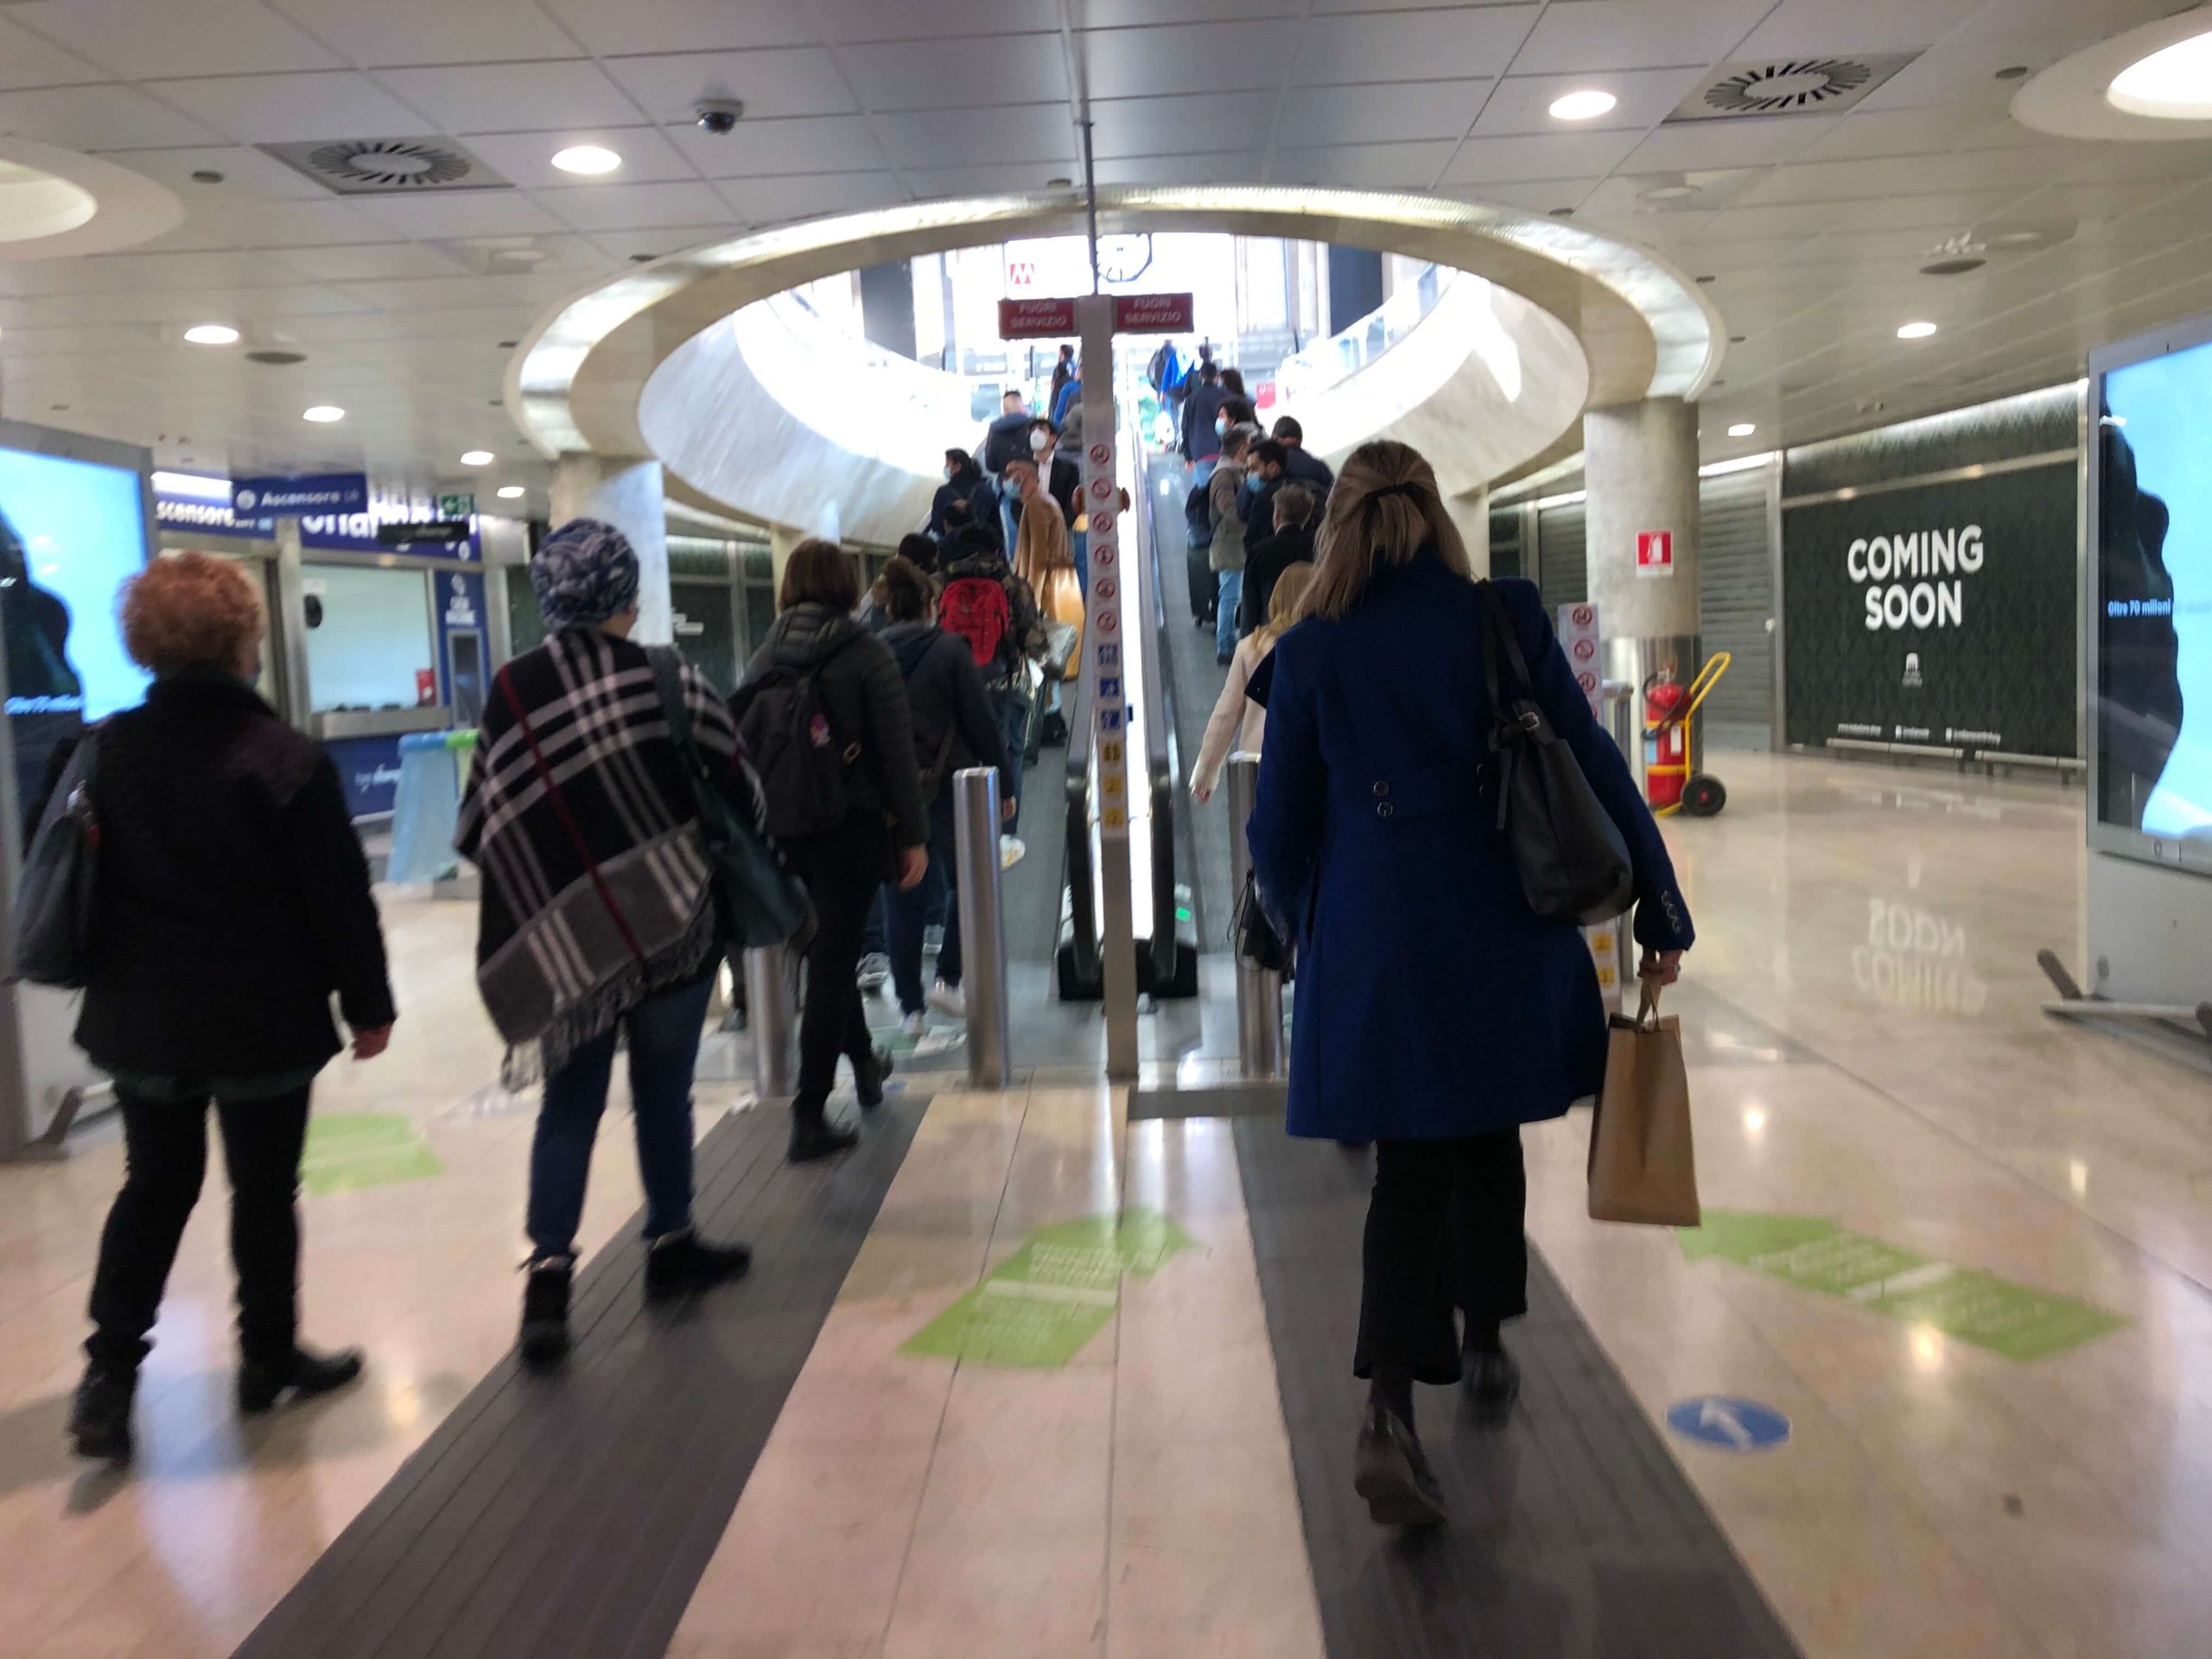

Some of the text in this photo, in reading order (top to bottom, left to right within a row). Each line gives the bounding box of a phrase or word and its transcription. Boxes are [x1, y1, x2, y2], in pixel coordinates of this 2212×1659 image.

[1019, 302, 1058, 314] FUORI
[1134, 296, 1172, 309] FUORI
[1010, 315, 1067, 328] SERVIZIO
[1125, 310, 1181, 325] SERVIZIO
[261, 489, 340, 507] Ascensore
[156, 499, 234, 527] scensore
[1847, 524, 1984, 584] COMING
[1865, 580, 1962, 632] SOON
[2108, 600, 2128, 618] Oltre
[2129, 599, 2140, 617] 70
[2141, 597, 2171, 616] milioni
